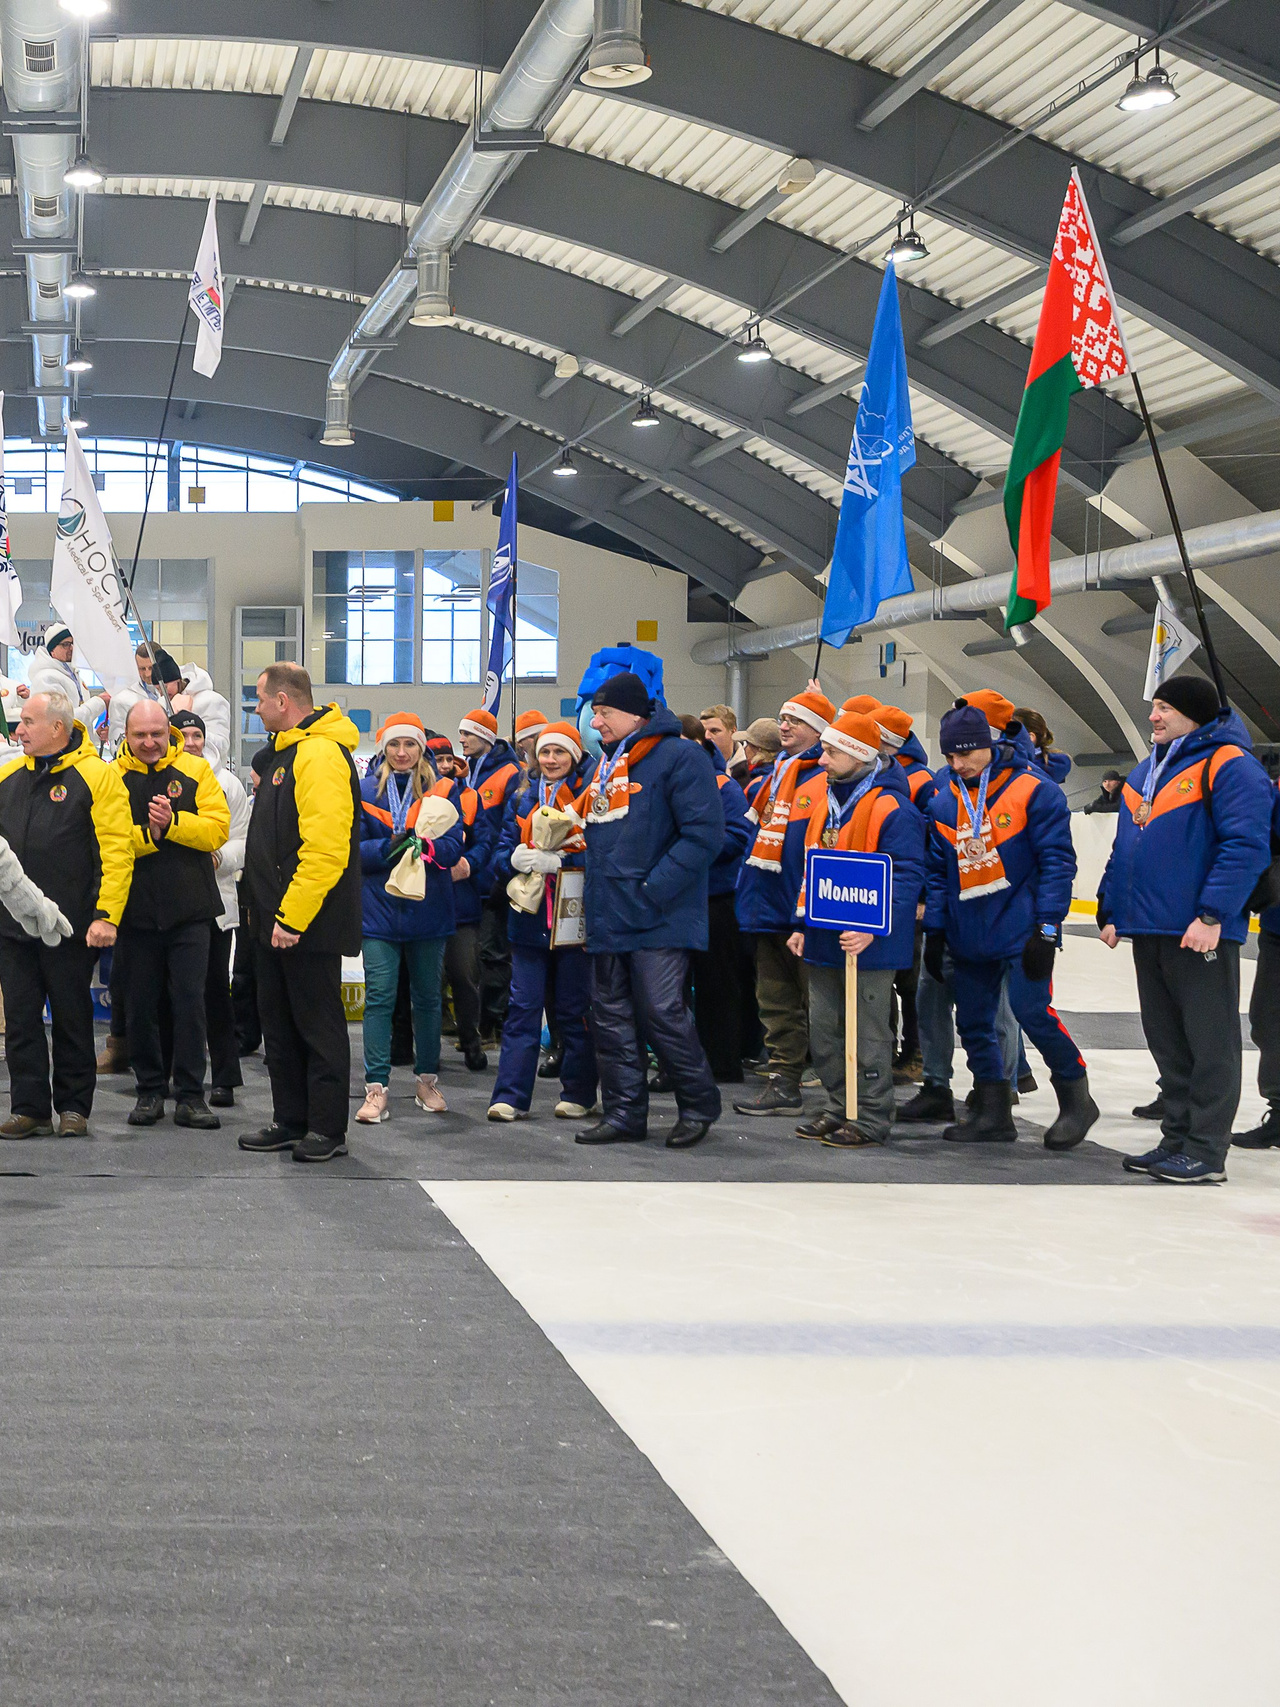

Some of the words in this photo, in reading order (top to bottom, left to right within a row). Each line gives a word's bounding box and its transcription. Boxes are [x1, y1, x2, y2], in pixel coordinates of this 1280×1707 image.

[64, 540, 88, 577] Medical
[86, 576, 94, 586] &
[91, 585, 106, 604] Spa
[102, 603, 123, 633] Resort
[818, 877, 878, 907] Молния
